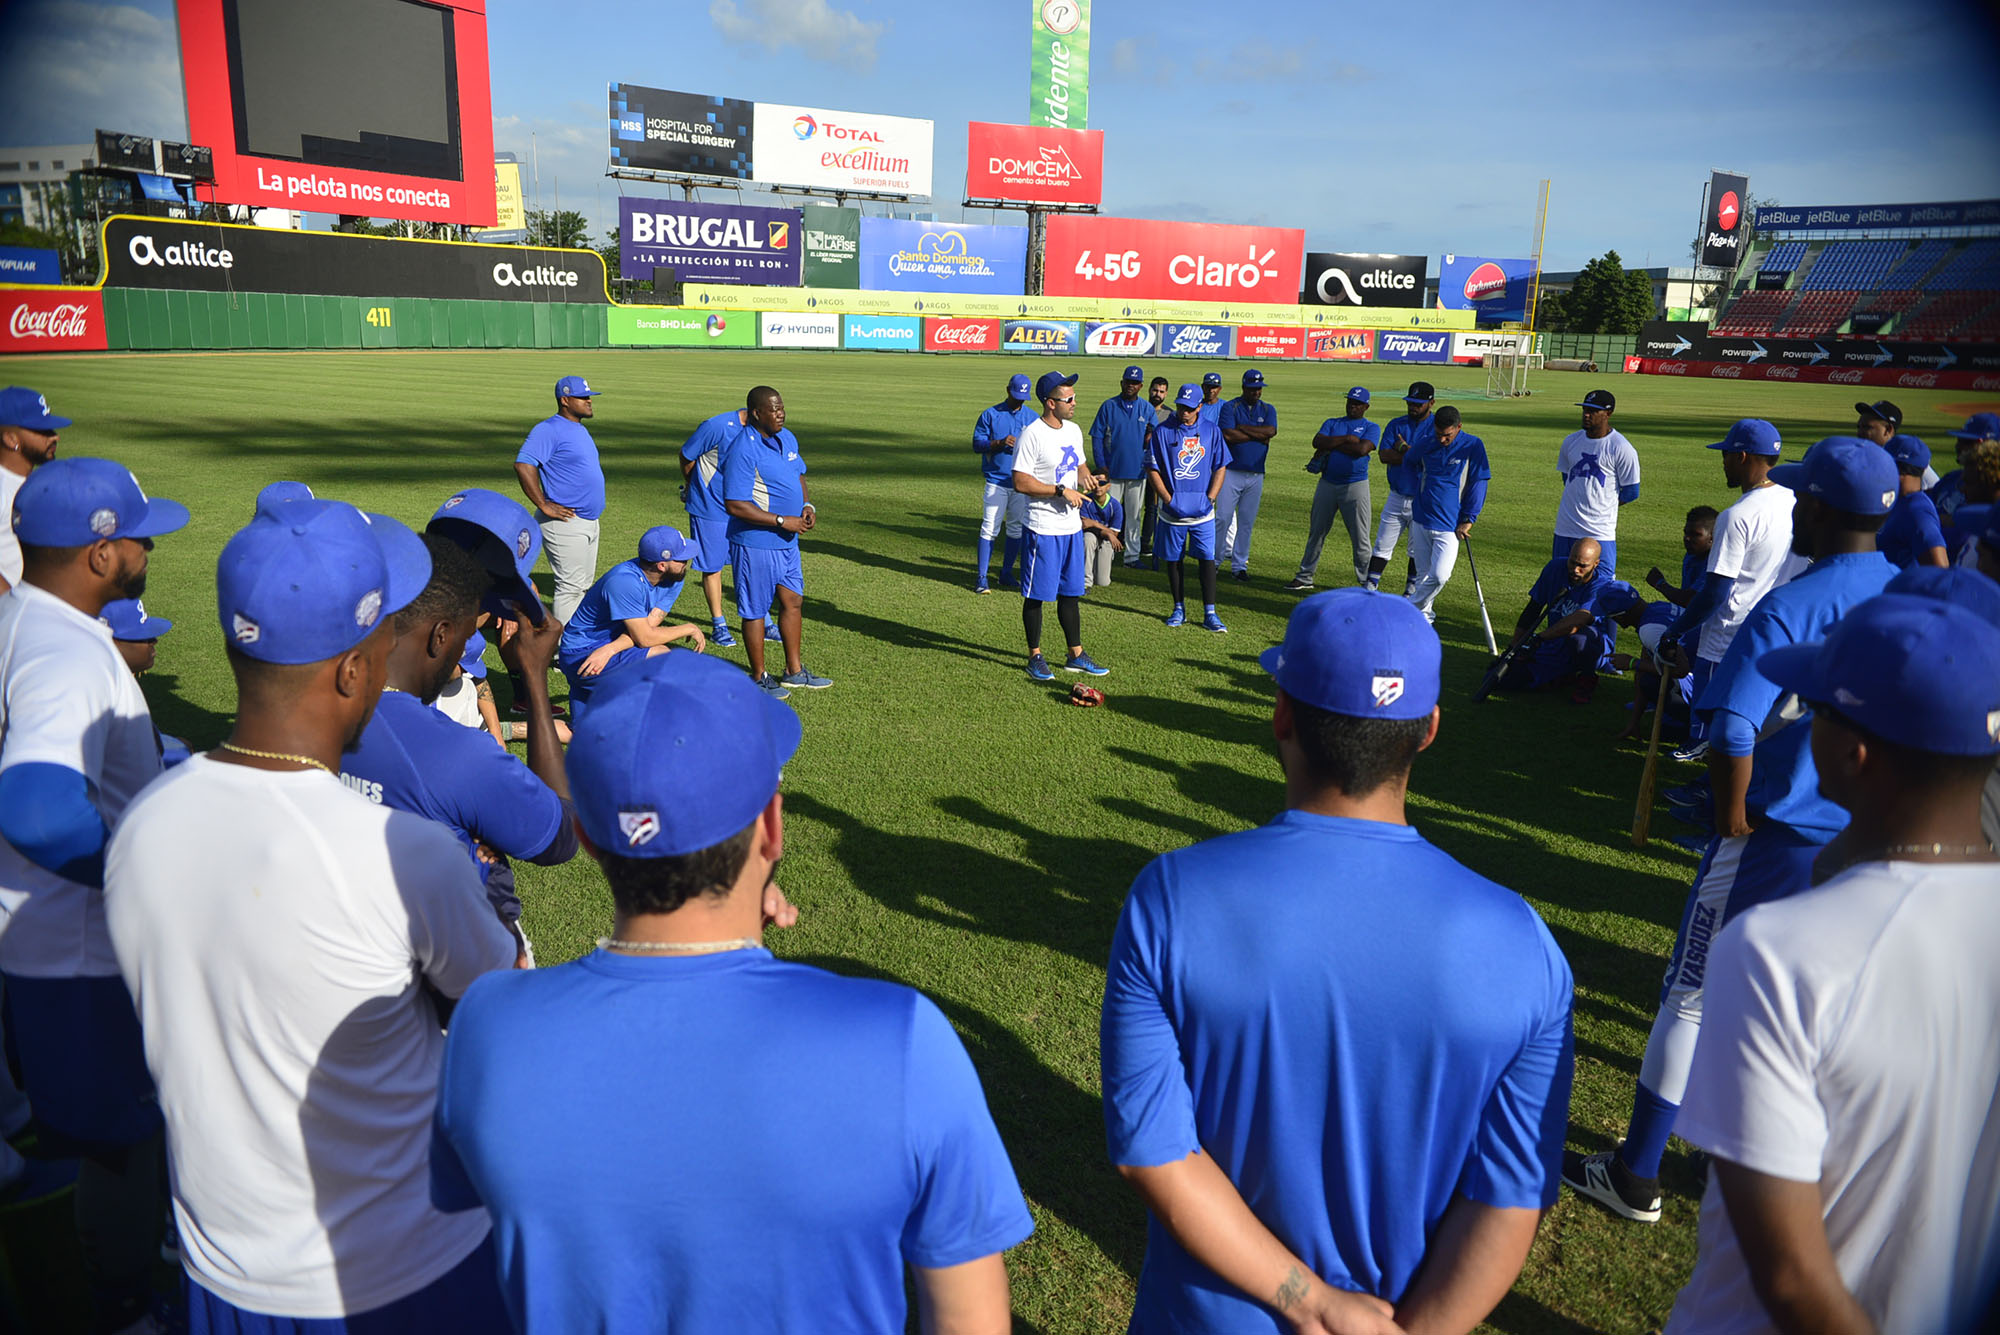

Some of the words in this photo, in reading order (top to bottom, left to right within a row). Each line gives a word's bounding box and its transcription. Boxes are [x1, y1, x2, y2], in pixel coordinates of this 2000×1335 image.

[1044, 41, 1070, 129] idente
[621, 120, 642, 132] HSS
[647, 118, 692, 133] HOSPITAL
[694, 124, 713, 135] FOR
[822, 123, 885, 143] TOTAL
[647, 129, 690, 144] SPECIAL
[691, 135, 736, 149] SURGERY
[821, 151, 909, 174] excellium
[989, 157, 1070, 179] DOMICEM
[257, 168, 283, 191] La
[287, 174, 348, 198] pelota
[351, 183, 383, 202] nos
[386, 187, 450, 208] conecta
[853, 177, 887, 187] SUPERIOR
[888, 179, 910, 189] FUELS
[1003, 176, 1034, 186] cemento
[1035, 178, 1046, 186] del
[1047, 178, 1070, 187] bueno
[168, 207, 187, 218] MPH
[1758, 212, 1800, 226] jetBlue
[1806, 211, 1850, 225] jetBlue
[1856, 209, 1902, 224] jetBlue
[632, 212, 764, 249] BRUGAL
[824, 240, 856, 251] LAFISE
[1707, 232, 1728, 248] Pizza
[1727, 235, 1739, 248] Hut
[165, 241, 234, 268] altice
[640, 254, 655, 263] LA
[661, 255, 730, 267] PERFECCIÓN
[735, 258, 754, 268] DEL
[759, 260, 782, 269] RON
[899, 251, 930, 262] Santo
[932, 253, 984, 266] Domingo
[888, 254, 926, 276] Quien
[1075, 250, 1141, 282] 4.5G
[1168, 254, 1261, 288] Claro
[521, 266, 578, 286] altice
[1360, 269, 1416, 290] altice
[965, 303, 999, 311] CONCRETOS
[10, 303, 89, 338] Coca-Cola
[366, 307, 391, 327] 411
[637, 320, 659, 328] Banco
[660, 320, 680, 329] BHD
[681, 320, 702, 329] León
[788, 325, 834, 334] HYUNDAI
[851, 324, 914, 339] Humano
[934, 324, 990, 344] Coca-Cola
[1009, 327, 1067, 344] ALEVE
[1175, 325, 1216, 340] Alka-
[1099, 330, 1141, 346] LTH
[1170, 338, 1222, 353] Seltzer
[1244, 336, 1278, 344] MAPFRE
[1314, 333, 1366, 352] TESAKA
[1384, 334, 1446, 356] Tropical
[1465, 338, 1517, 348] PAWA
[1648, 342, 1692, 350] POWERADE
[1722, 349, 1768, 358] POWERADE
[1783, 351, 1830, 360] POWERADE
[1845, 353, 1893, 362] POWERADE
[1658, 362, 1688, 374] Coca-Cola
[1711, 365, 1742, 377] Coca-Cola
[1766, 365, 1800, 378] Coca-Cola
[1828, 370, 1864, 383] Coca-Cola
[1680, 902, 1717, 989] VASQUEZ
